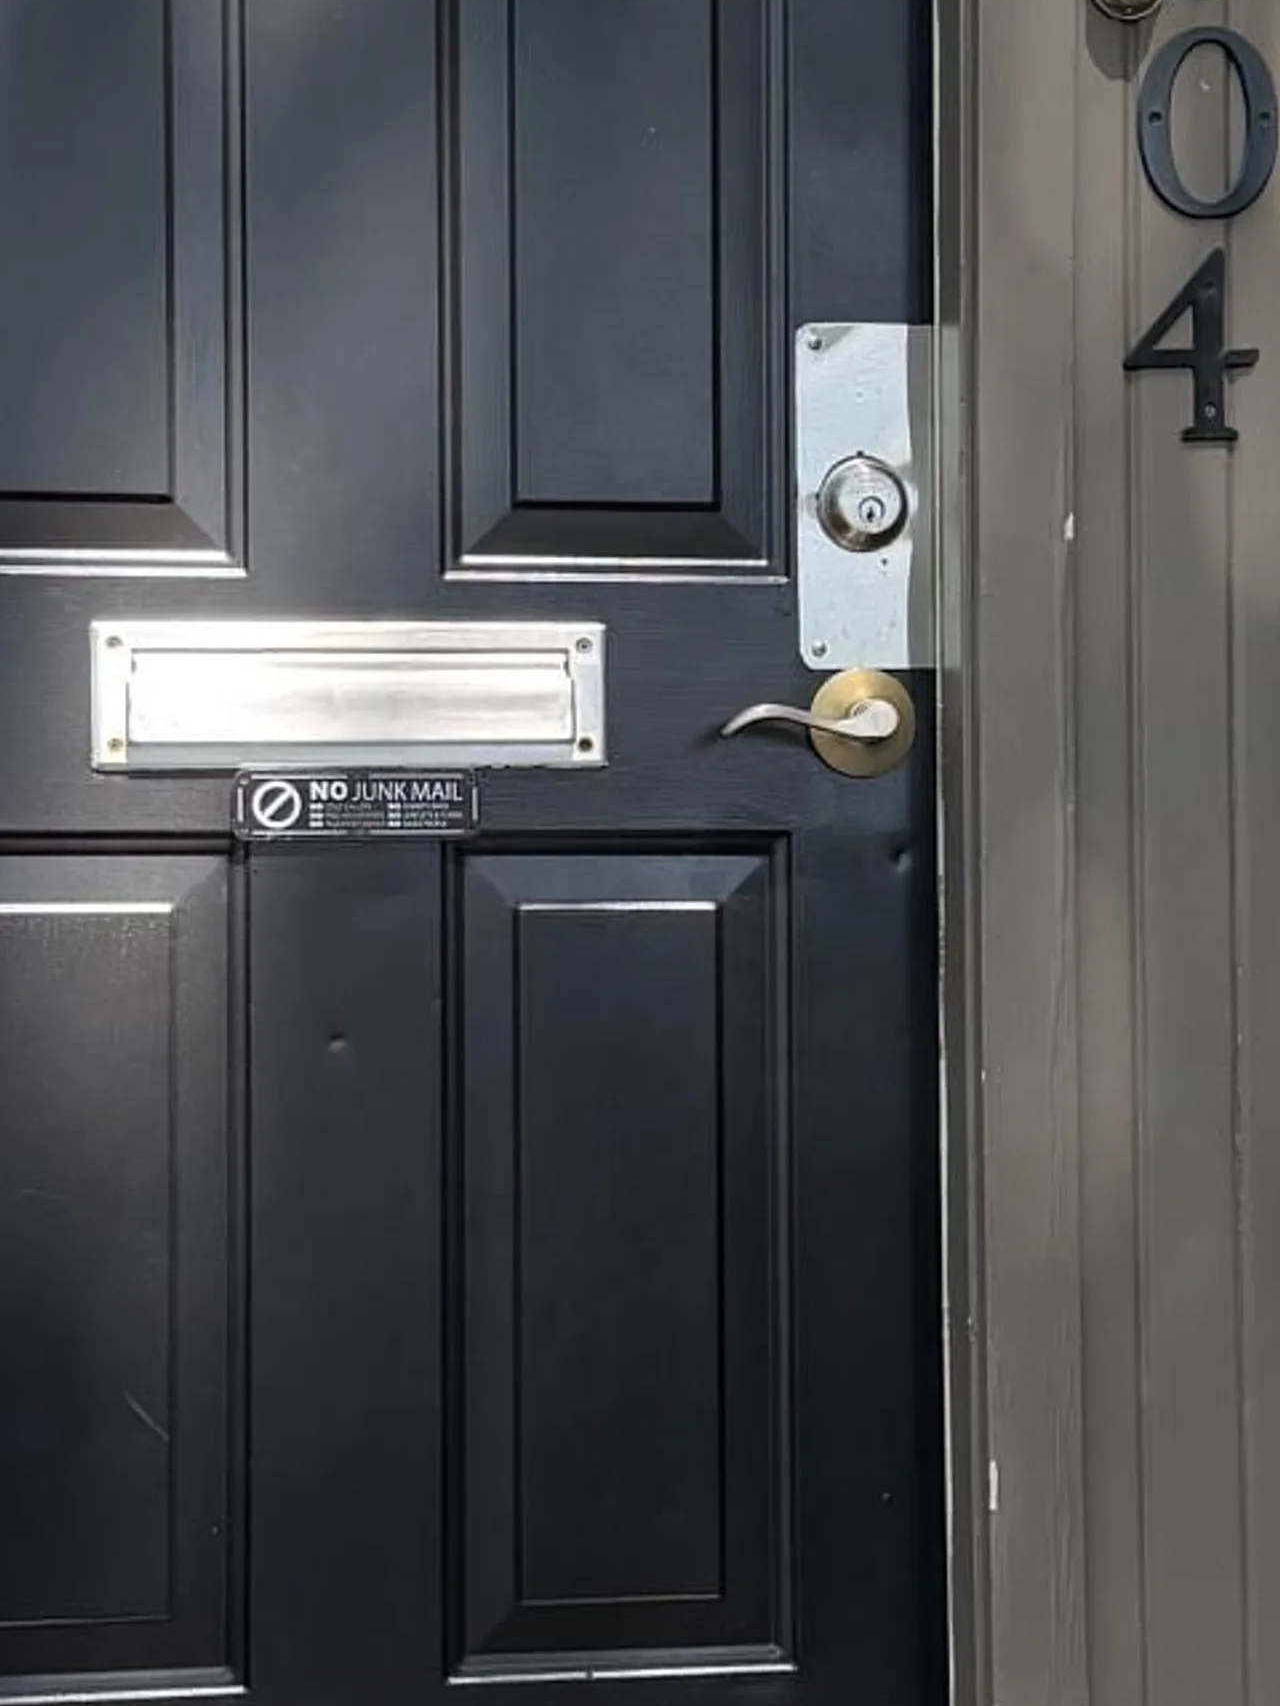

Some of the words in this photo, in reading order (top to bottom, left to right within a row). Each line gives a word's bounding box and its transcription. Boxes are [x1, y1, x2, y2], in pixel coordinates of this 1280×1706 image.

[309, 780, 348, 801] NO
[351, 780, 407, 801] JUNK
[410, 780, 463, 801] MAIL
